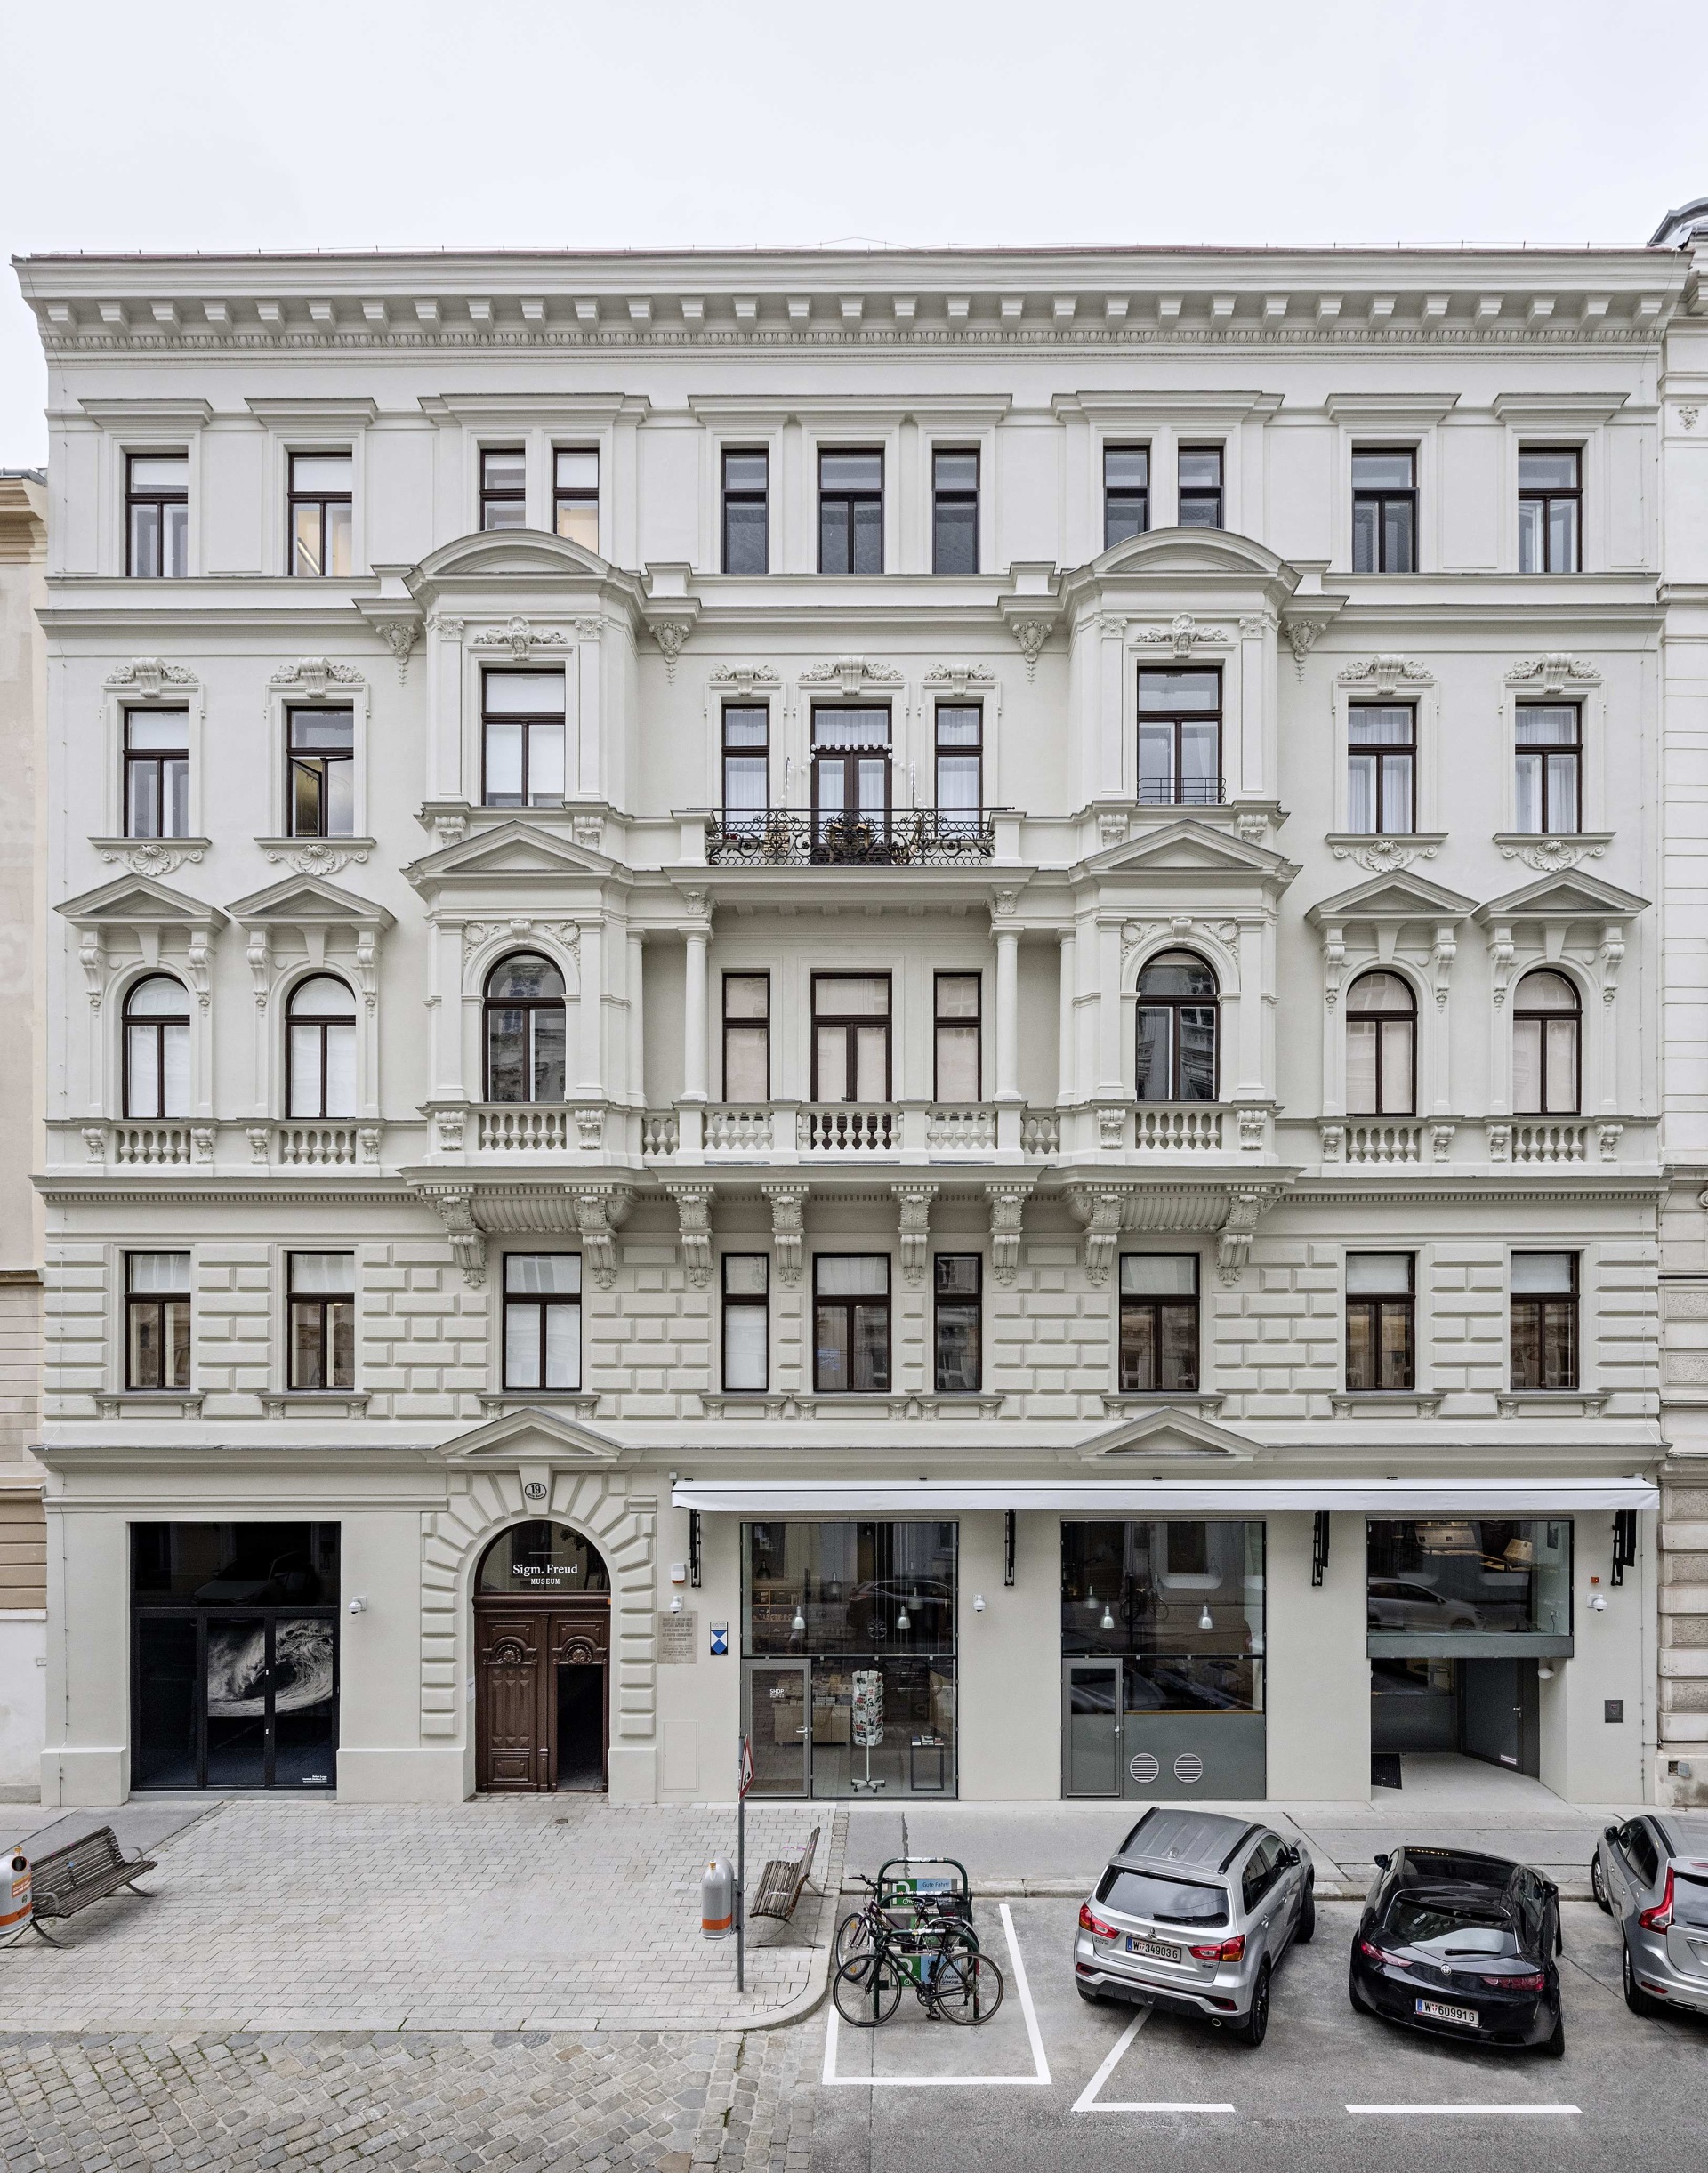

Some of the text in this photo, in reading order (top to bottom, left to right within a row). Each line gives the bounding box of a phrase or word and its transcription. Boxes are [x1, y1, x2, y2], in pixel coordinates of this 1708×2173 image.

[530, 1485, 541, 1494] 19
[512, 1564, 578, 1577] Sigm. Freud
